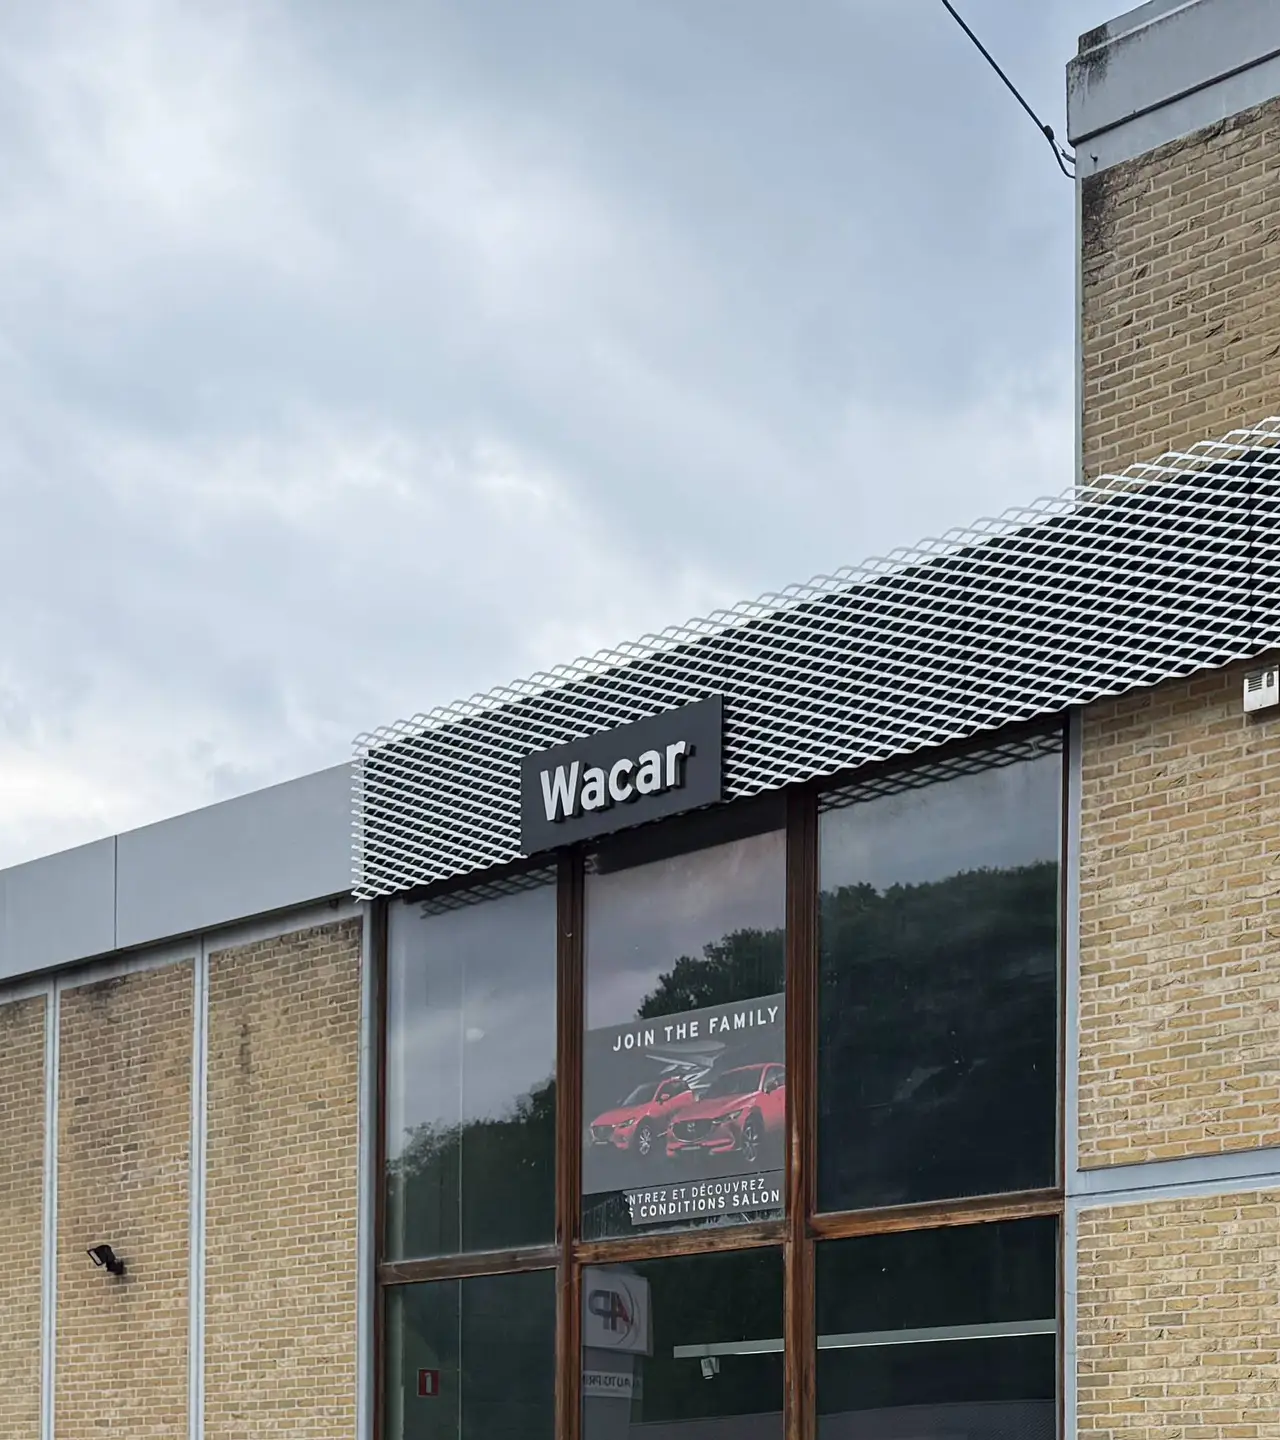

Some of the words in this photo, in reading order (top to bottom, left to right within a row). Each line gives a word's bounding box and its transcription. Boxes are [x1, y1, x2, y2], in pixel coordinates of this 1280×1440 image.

[540, 740, 688, 822] Wacar
[613, 1029, 655, 1052] JOIN
[664, 1021, 699, 1042] THE
[709, 1006, 779, 1034] FAMILY
[624, 1190, 666, 1206] NTREZ
[672, 1188, 686, 1201] ET
[691, 1178, 765, 1198] DÉCOUVREZ
[640, 1196, 726, 1218] CONDITIONS
[732, 1189, 780, 1207] SALON
